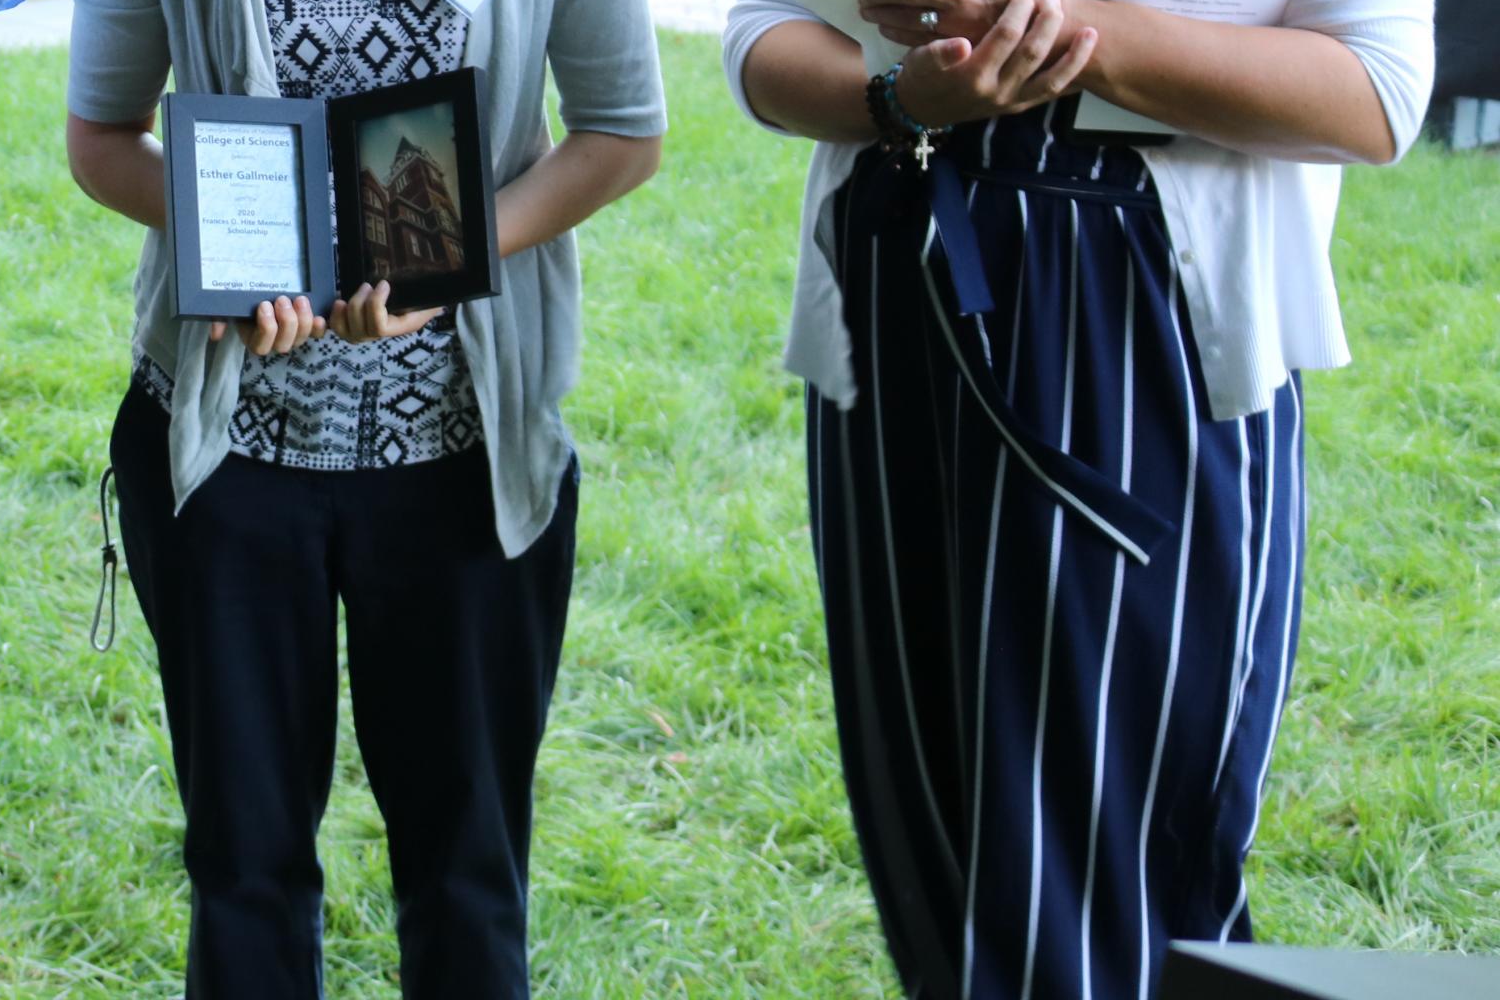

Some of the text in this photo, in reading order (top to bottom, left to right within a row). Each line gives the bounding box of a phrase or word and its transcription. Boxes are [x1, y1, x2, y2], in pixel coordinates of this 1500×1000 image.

[195, 134, 290, 147] College of Sciences
[200, 169, 289, 182] Esther Gallmeier
[227, 227, 268, 235] Scholarship
[212, 280, 243, 289] Georgia
[249, 281, 279, 289] College
